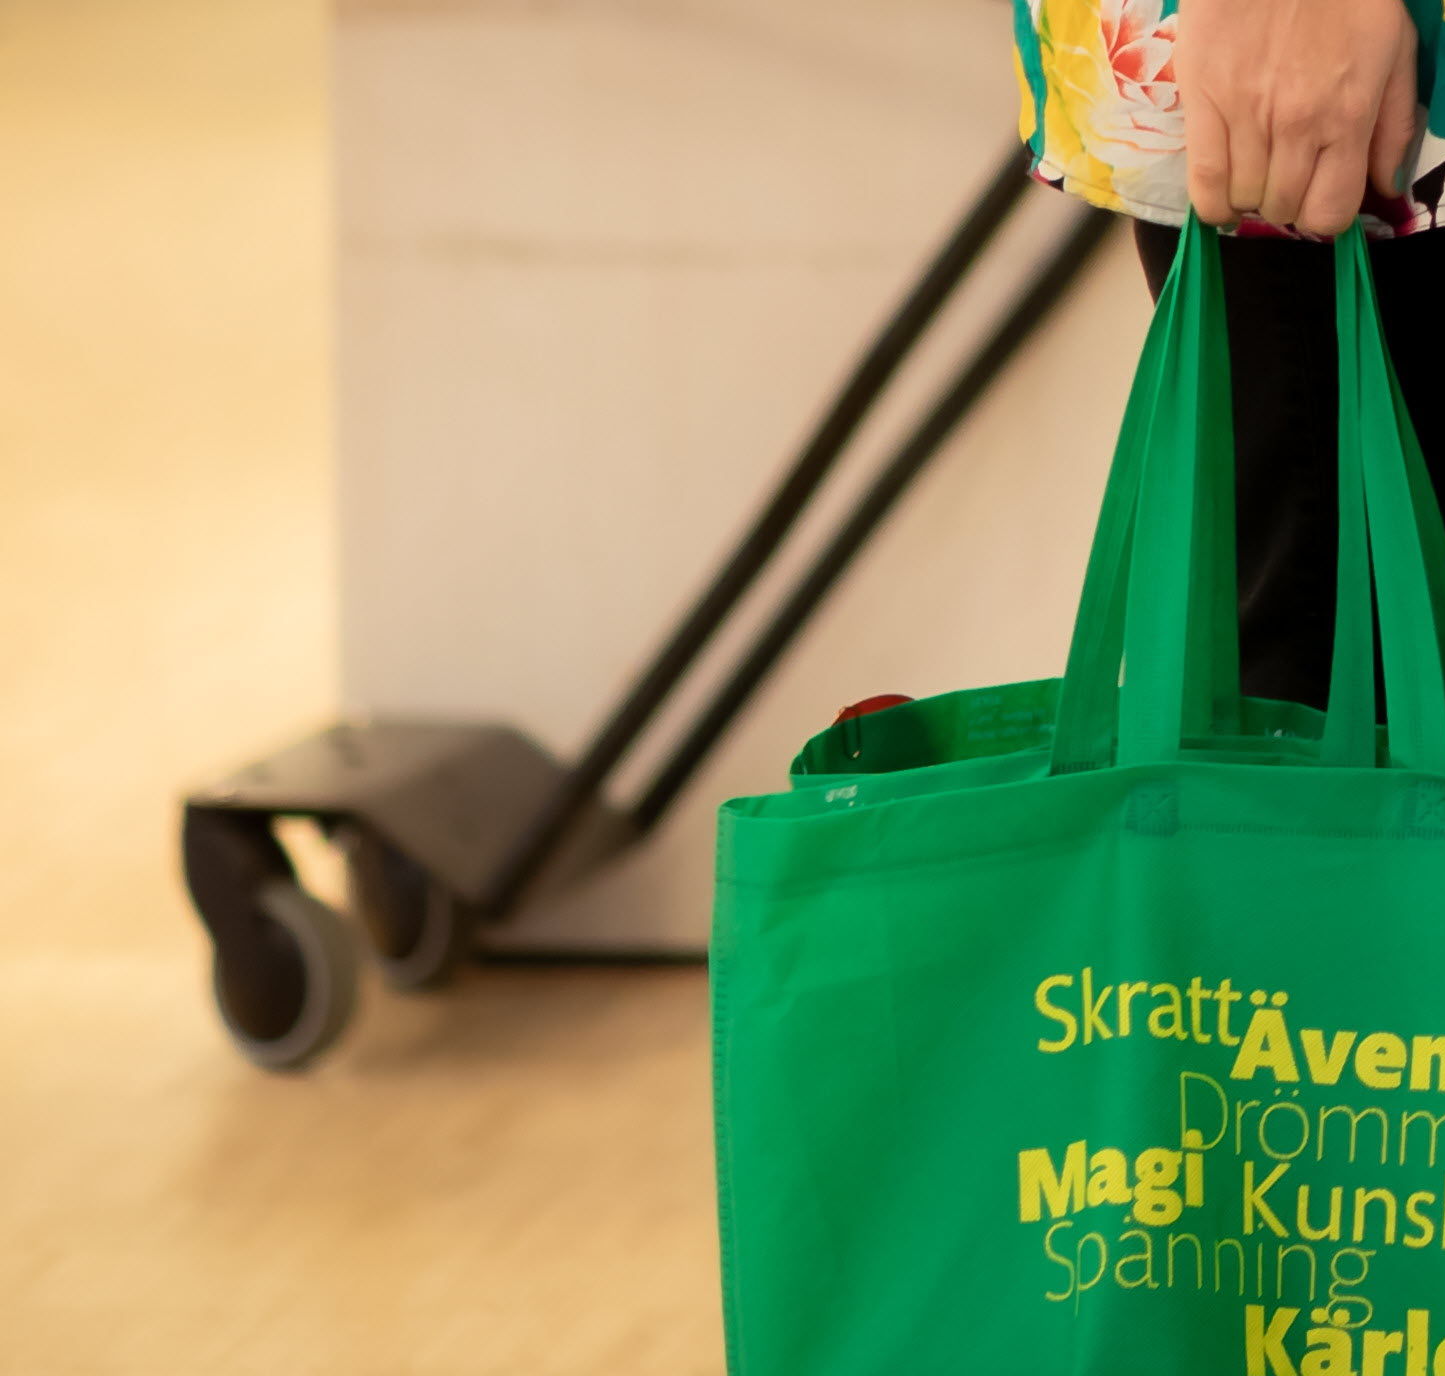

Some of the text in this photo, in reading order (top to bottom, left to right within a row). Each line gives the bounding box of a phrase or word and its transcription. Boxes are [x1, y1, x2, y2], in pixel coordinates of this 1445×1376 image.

[1034, 966, 1242, 1053] Skratt
[1018, 1129, 1204, 1227] Magi
[1043, 1219, 1376, 1329] Spänning
